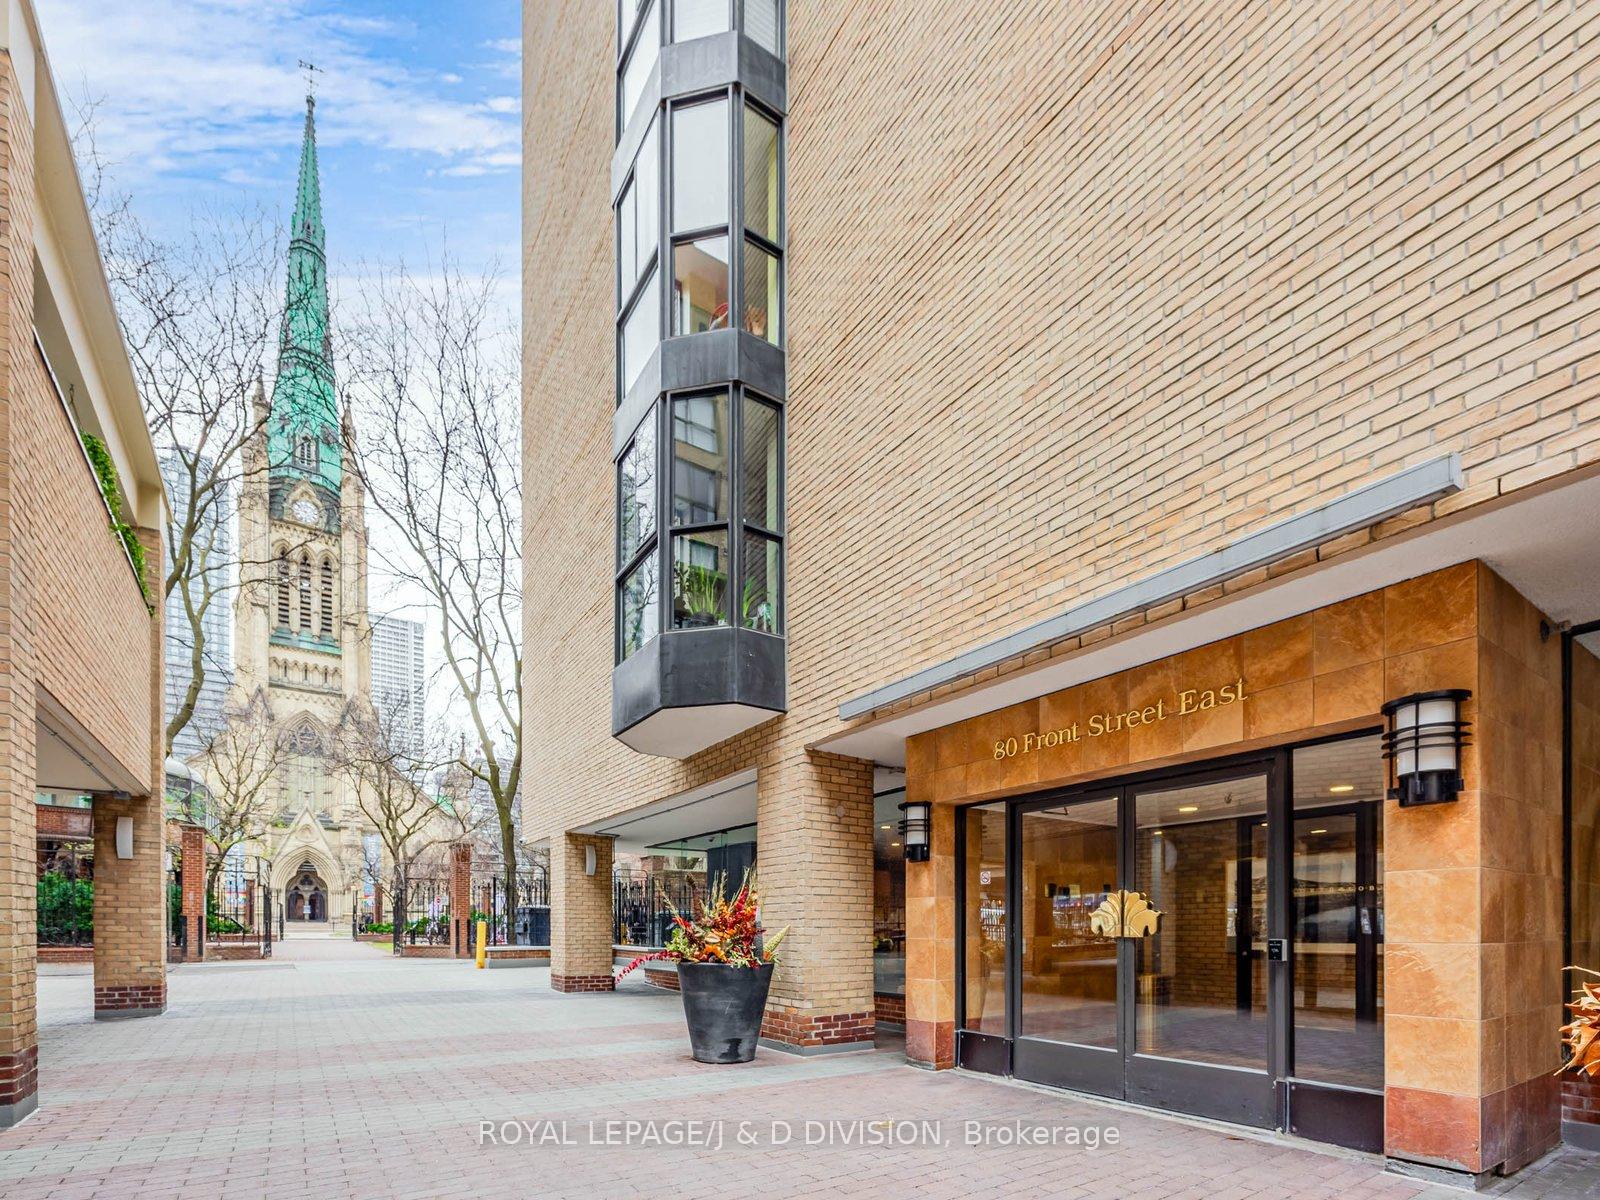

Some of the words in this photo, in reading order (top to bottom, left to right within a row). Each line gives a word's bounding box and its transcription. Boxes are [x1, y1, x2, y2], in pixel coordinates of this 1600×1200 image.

[993, 737, 1017, 760] 80
[1023, 721, 1080, 753] Front
[1087, 698, 1166, 737] Street
[1178, 677, 1248, 716] East
